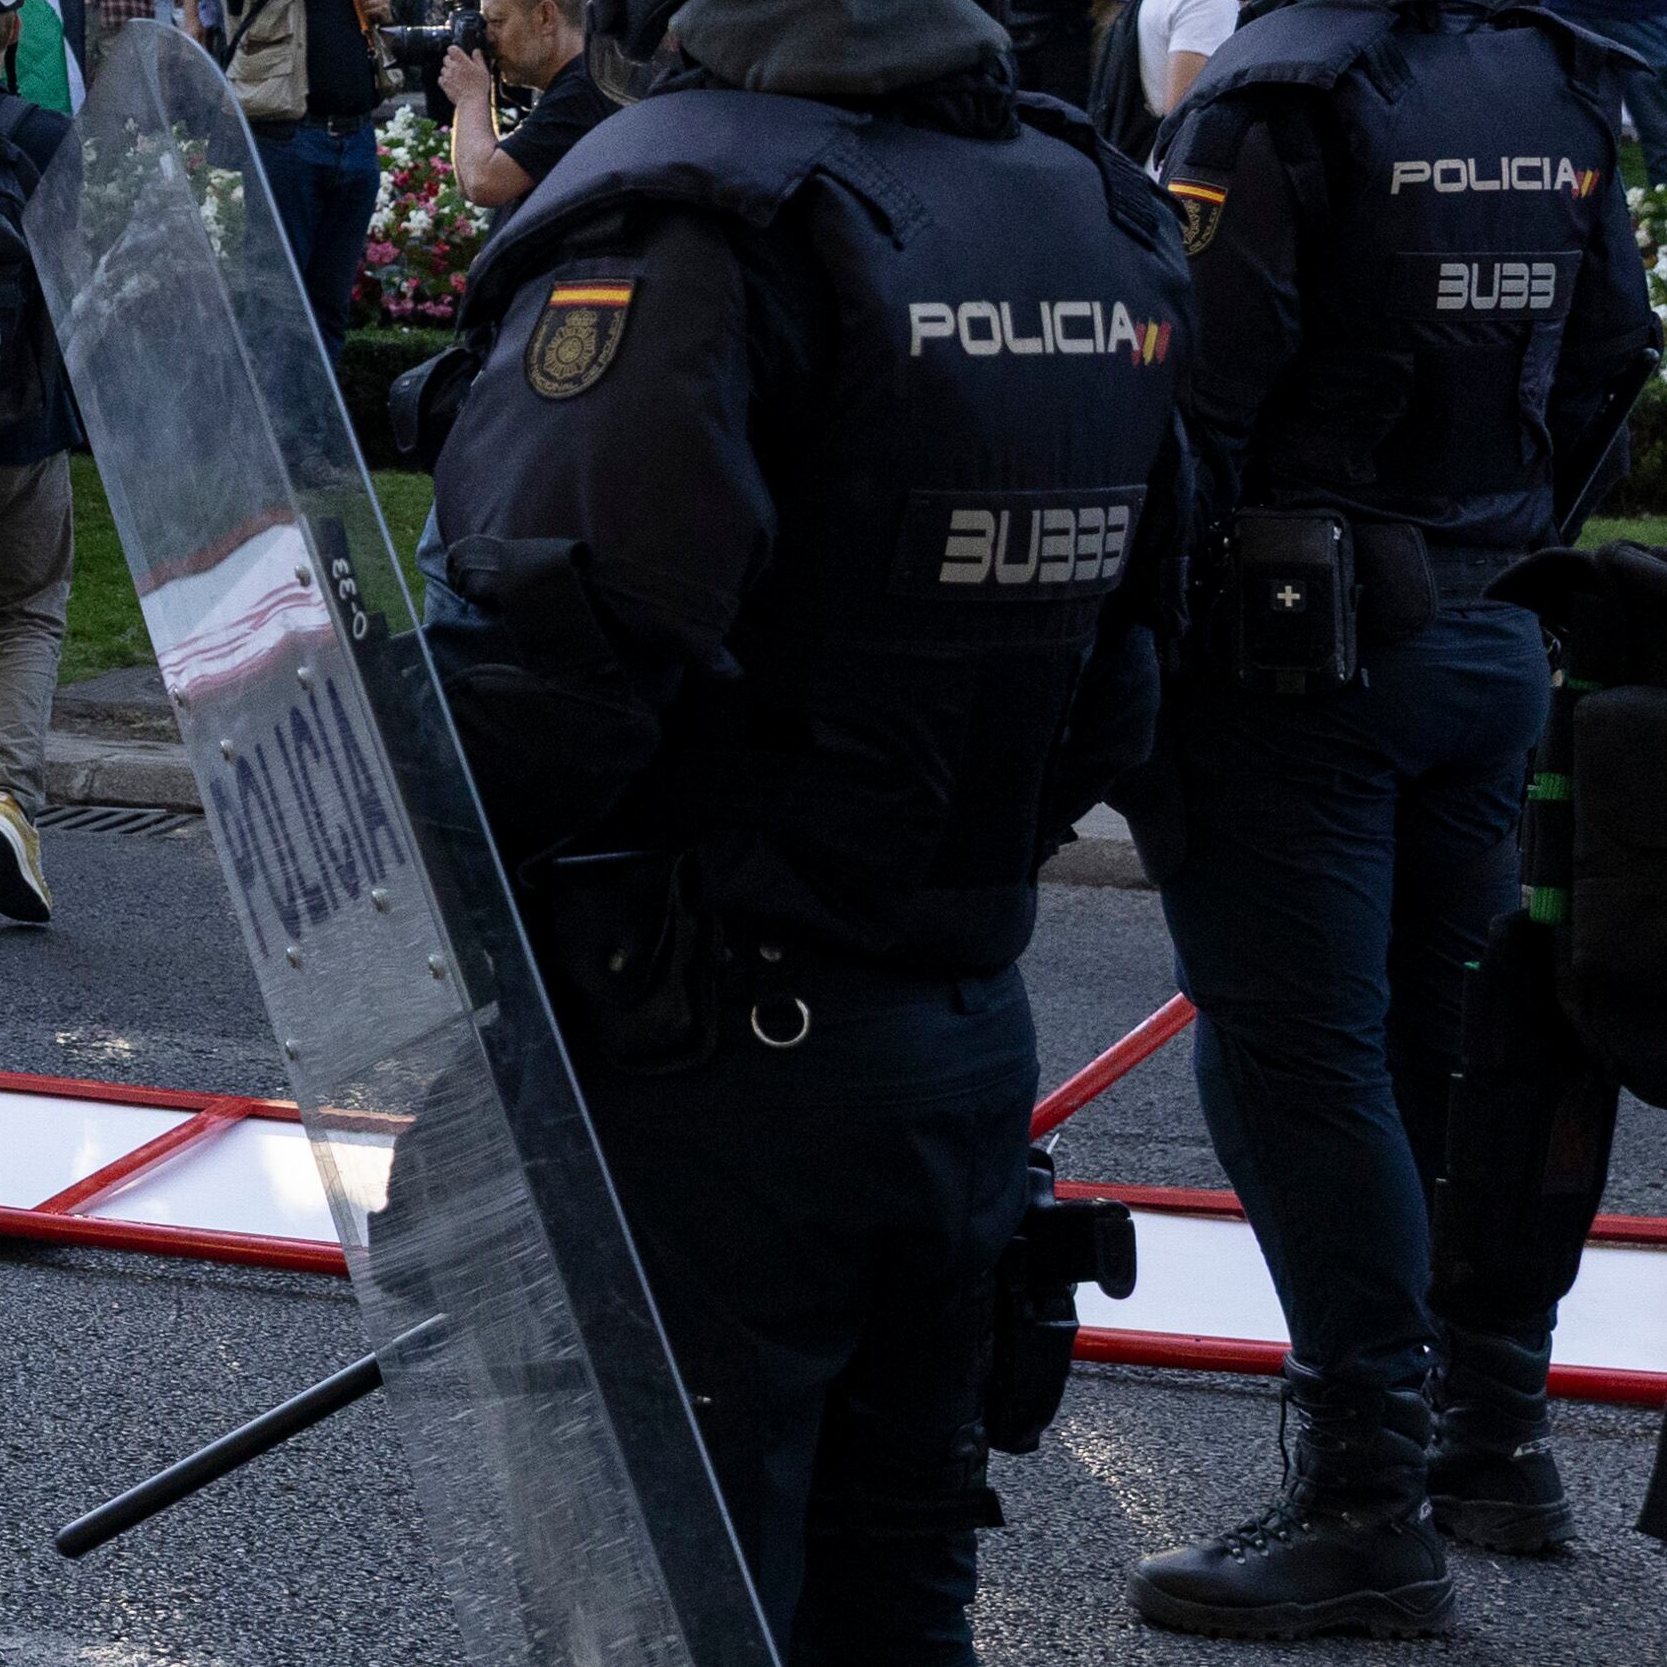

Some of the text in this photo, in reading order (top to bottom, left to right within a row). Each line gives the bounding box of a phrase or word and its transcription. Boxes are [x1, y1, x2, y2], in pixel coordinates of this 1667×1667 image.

[1390, 156, 1579, 196] POLICIA
[907, 300, 1141, 357] POLICIA
[209, 676, 407, 958] POLICIA
